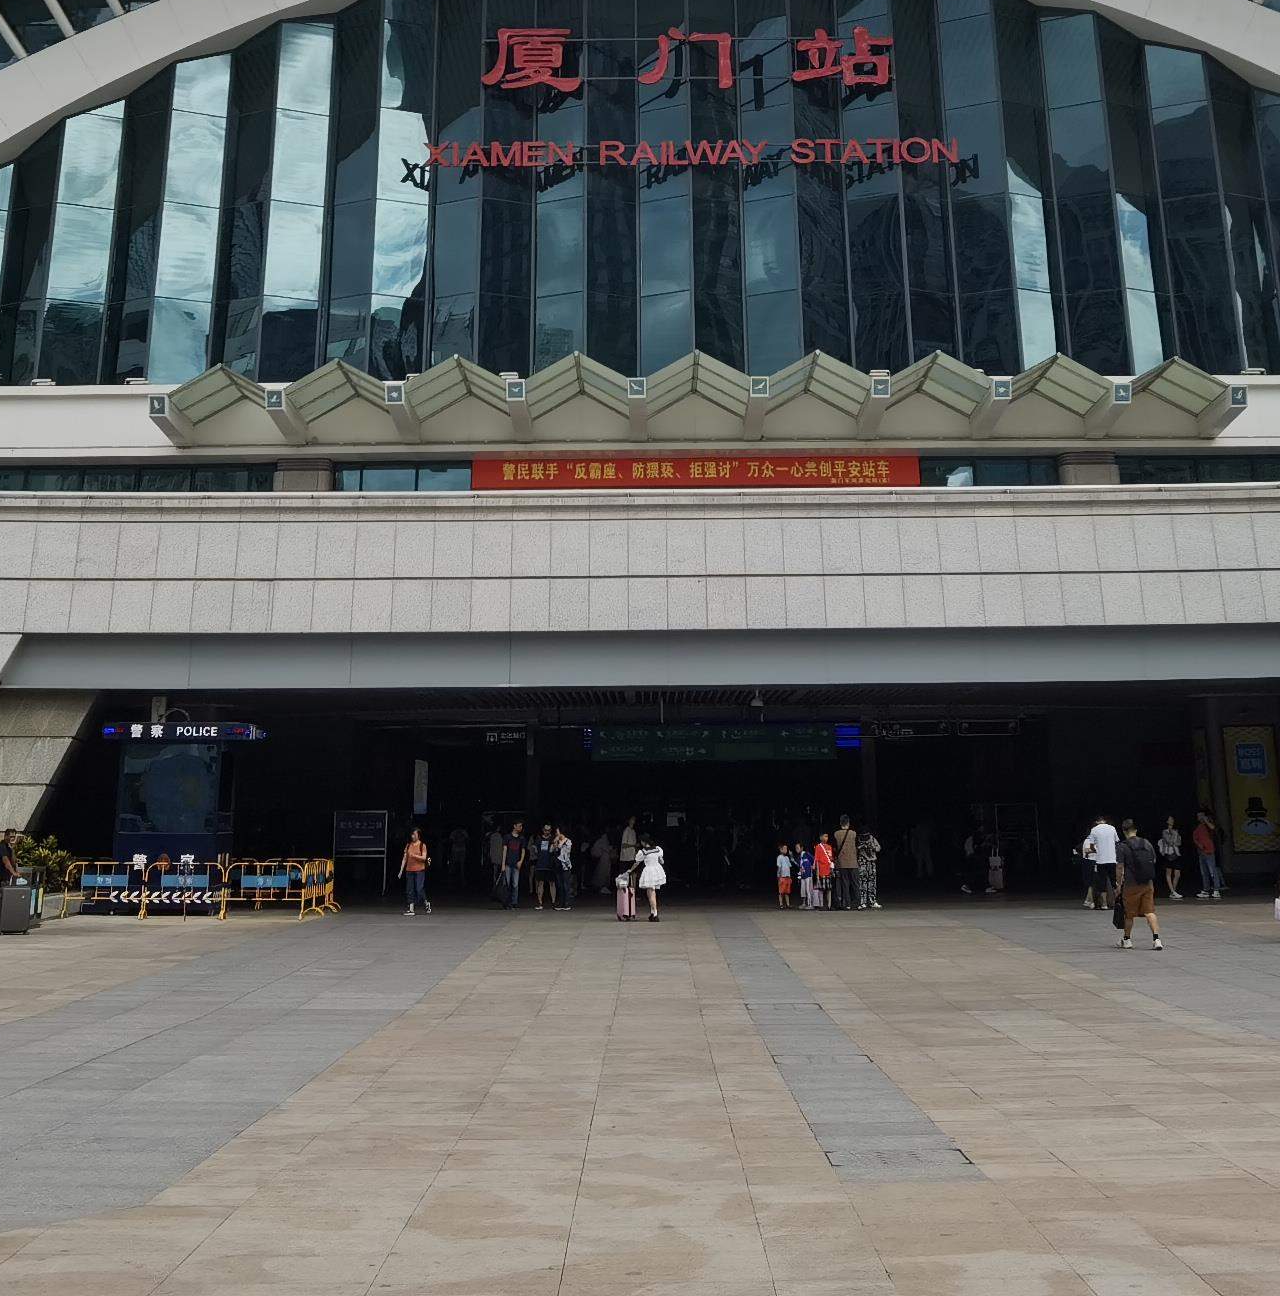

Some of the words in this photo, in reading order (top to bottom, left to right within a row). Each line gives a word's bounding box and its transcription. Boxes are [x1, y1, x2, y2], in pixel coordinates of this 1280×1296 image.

[482, 26, 893, 91] 厦门站
[424, 140, 575, 168] XIAMEN
[599, 140, 767, 167] RAILWAY
[790, 137, 959, 164] STATION
[130, 723, 164, 739] 警察
[176, 726, 218, 737] POLICE
